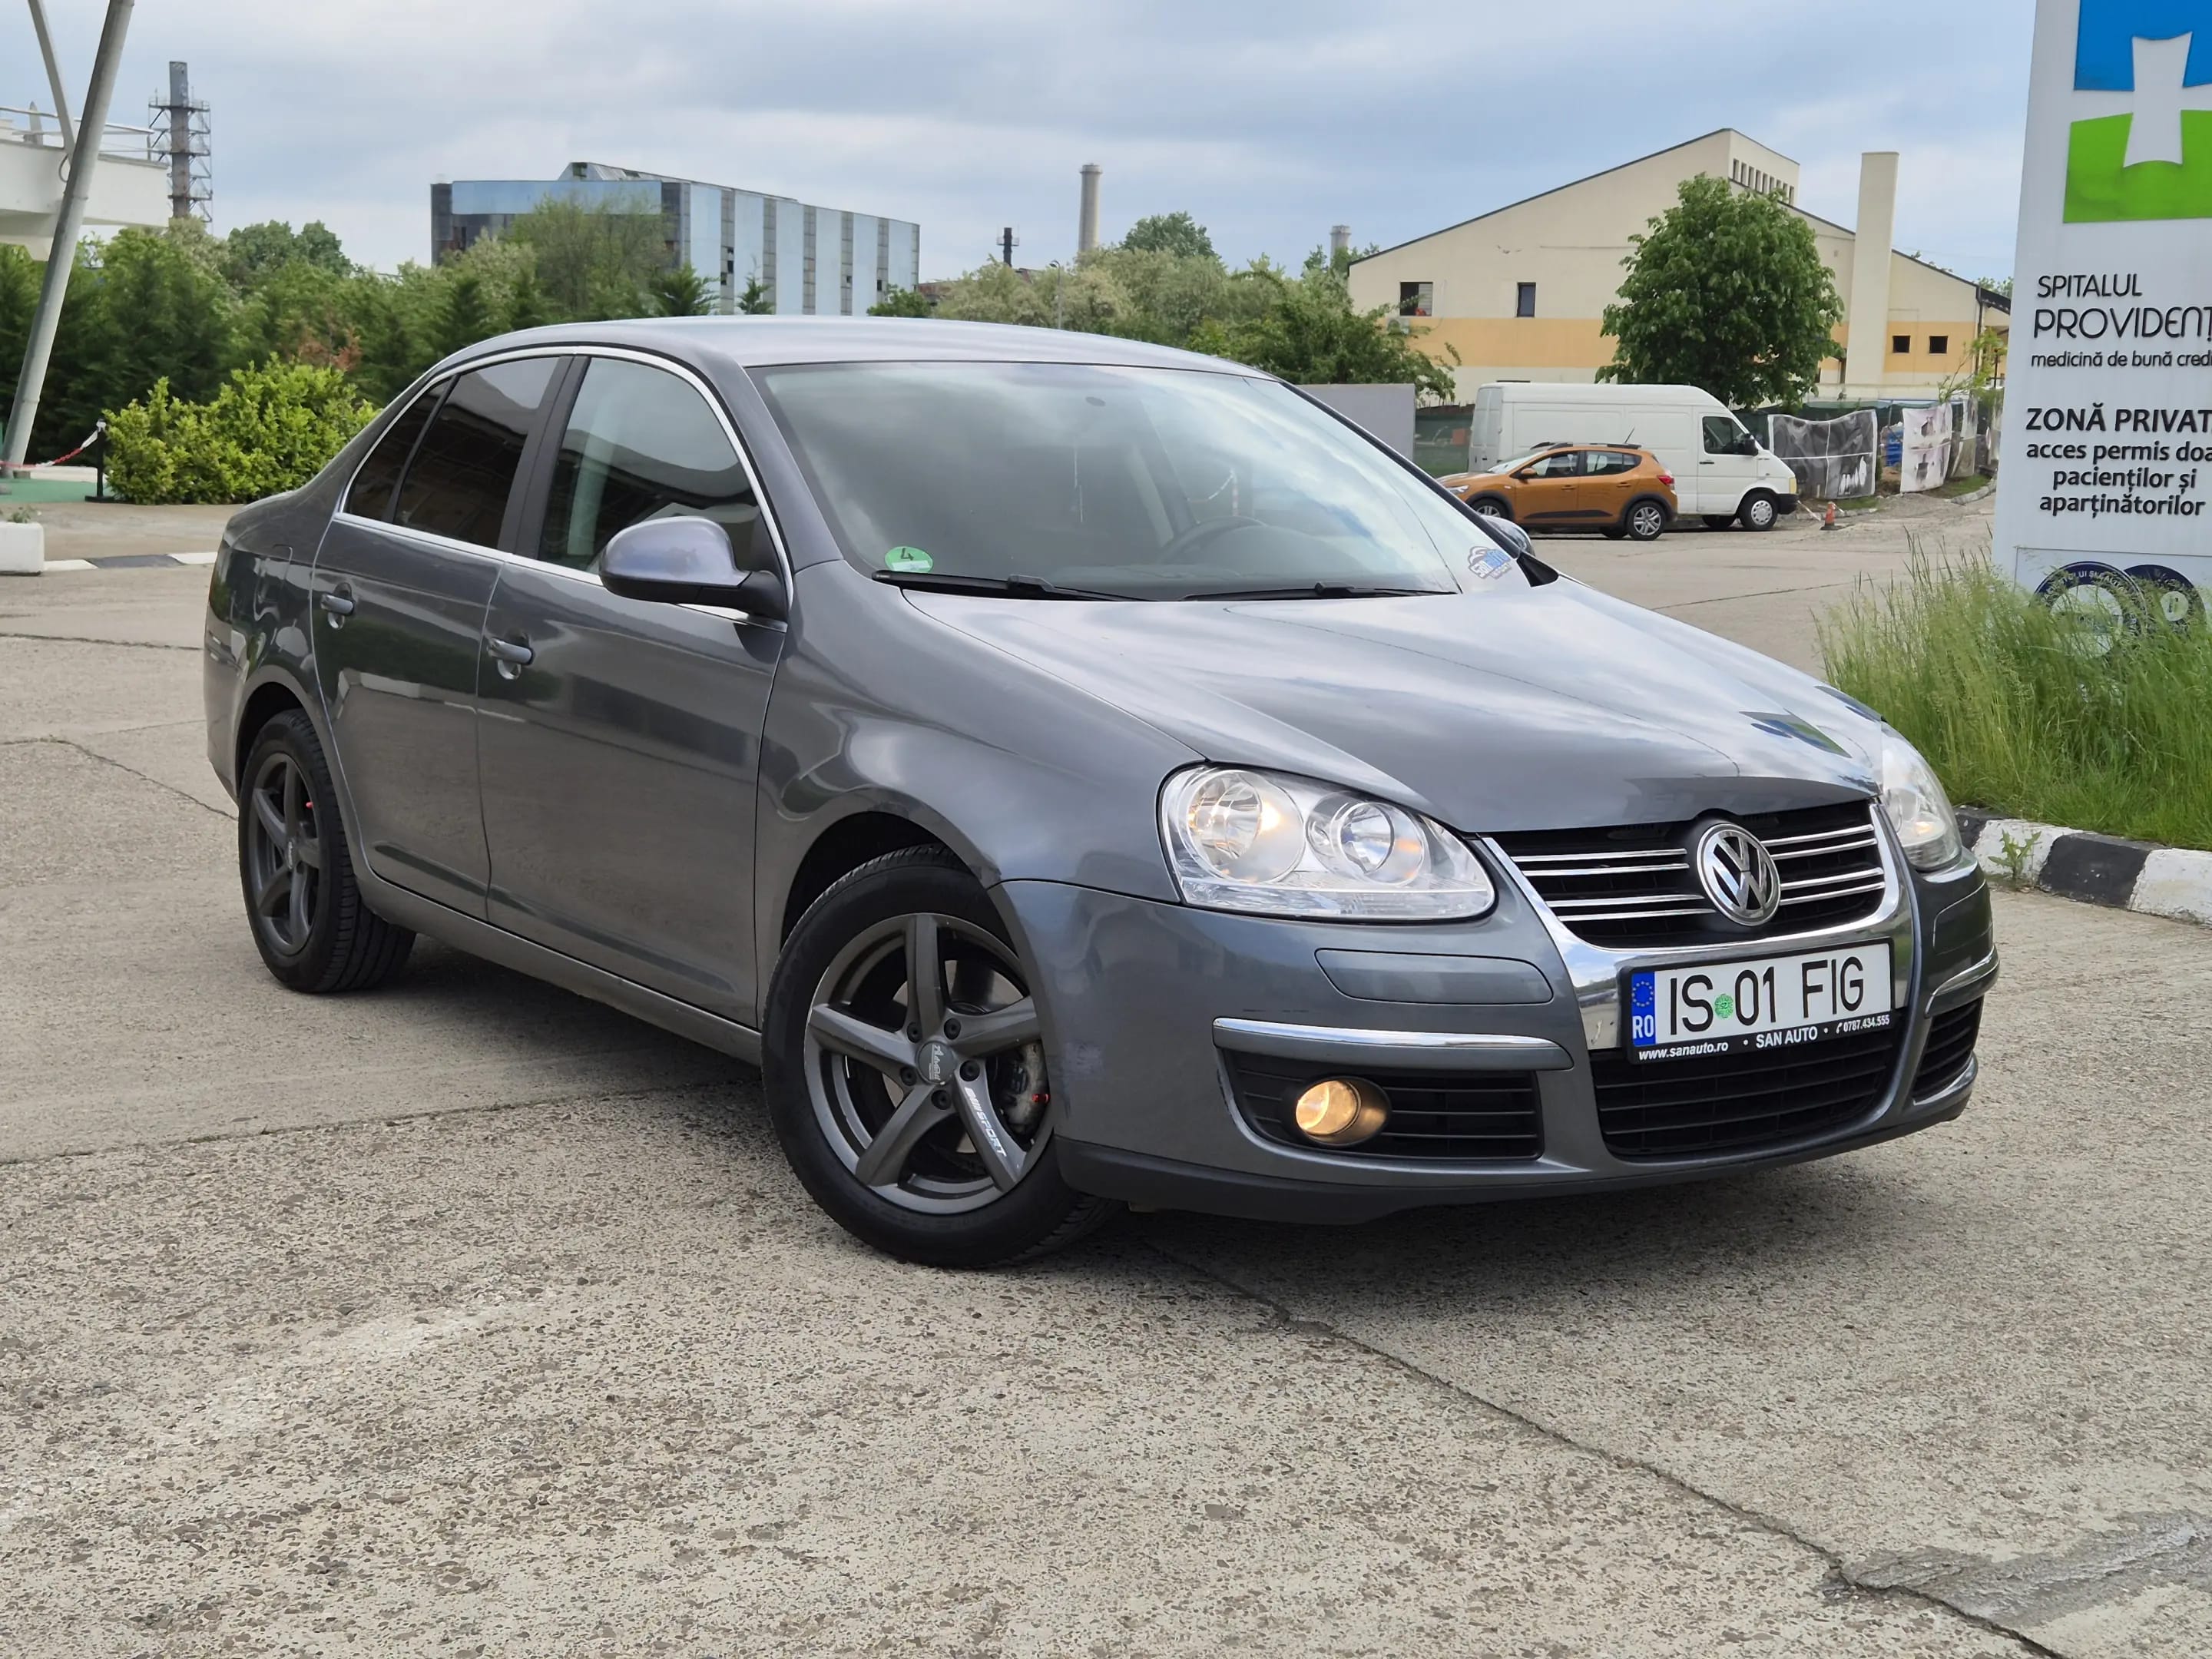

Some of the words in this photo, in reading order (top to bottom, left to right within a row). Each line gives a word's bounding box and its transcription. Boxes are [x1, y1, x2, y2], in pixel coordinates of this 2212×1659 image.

[2037, 273, 2143, 298] SPITALUL
[2031, 351, 2103, 367] medicină
[2107, 350, 2128, 367] de
[2131, 350, 2173, 367] bună
[2025, 402, 2107, 432] ZONĂ
[2114, 409, 2212, 432] PRIVAT
[2026, 442, 2087, 459] acces
[2092, 440, 2171, 465] permis
[2052, 466, 2175, 493] pacienților
[2178, 468, 2198, 495] și
[2039, 493, 2207, 519] aparținătorilor
[900, 548, 914, 561] 4
[1670, 974, 1714, 1035] IS
[1734, 966, 1777, 1026] 01
[1802, 956, 1864, 1018] FIG
[1632, 1015, 1654, 1039] RO
[1638, 1040, 1729, 1061] www.sanauto.ro
[1756, 1031, 1783, 1049] SAN
[1785, 1025, 1818, 1045] AUTO
[976, 1111, 1007, 1157] SPORT
